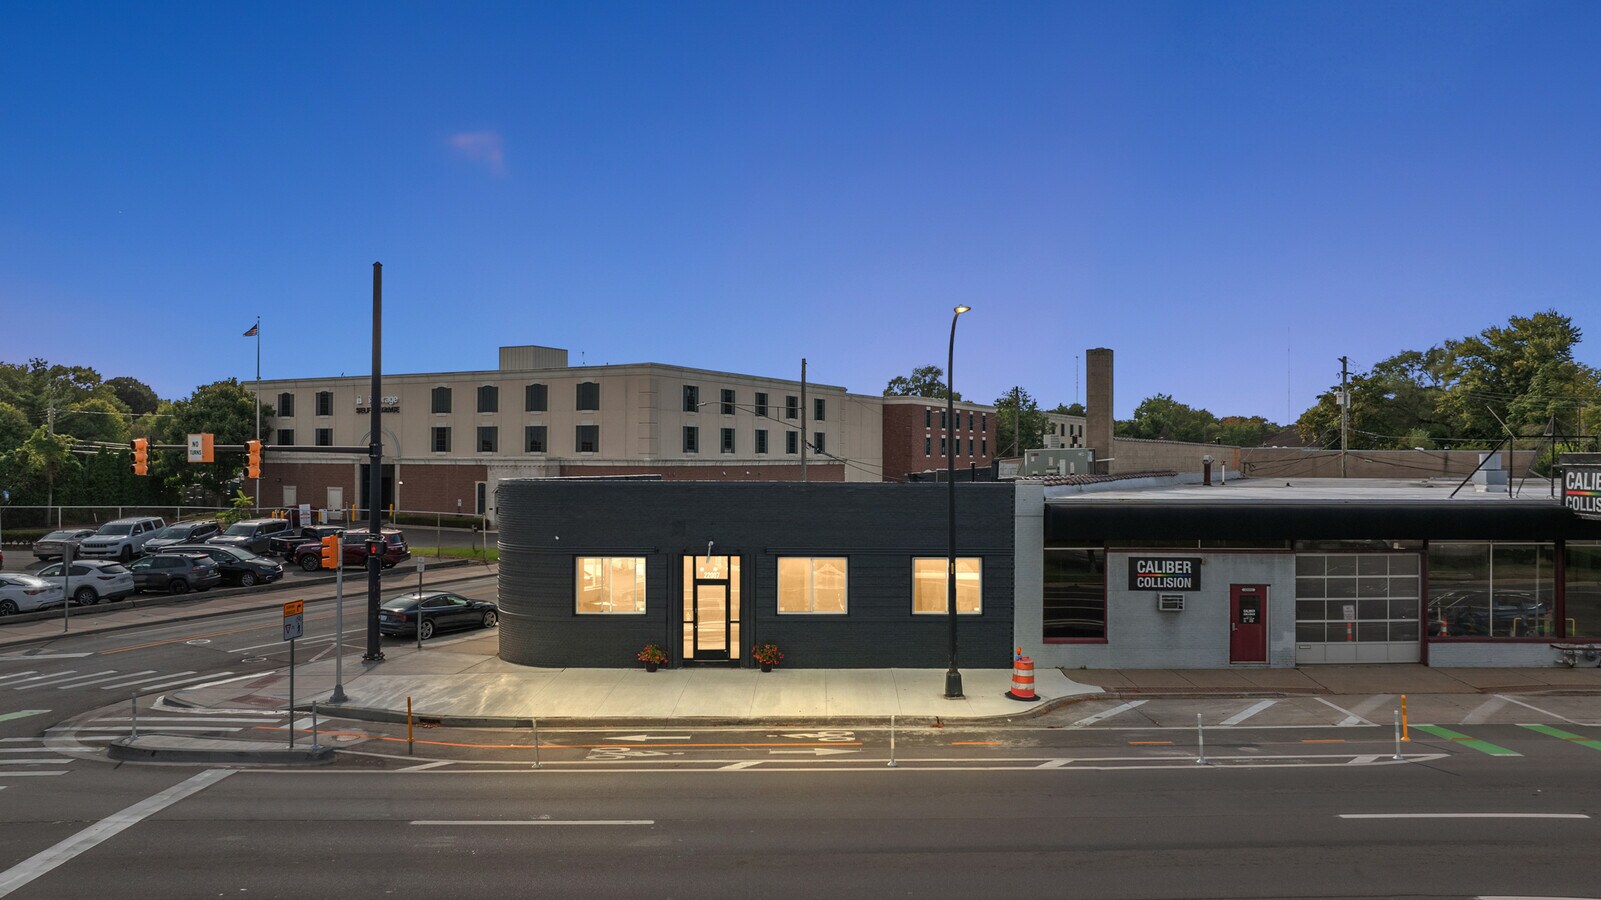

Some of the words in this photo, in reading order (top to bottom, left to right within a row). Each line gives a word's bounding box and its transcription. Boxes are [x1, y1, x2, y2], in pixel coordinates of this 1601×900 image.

[191, 440, 200, 448] NO
[1136, 560, 1192, 574] CALIBER
[1136, 577, 1192, 588] COLLISION
